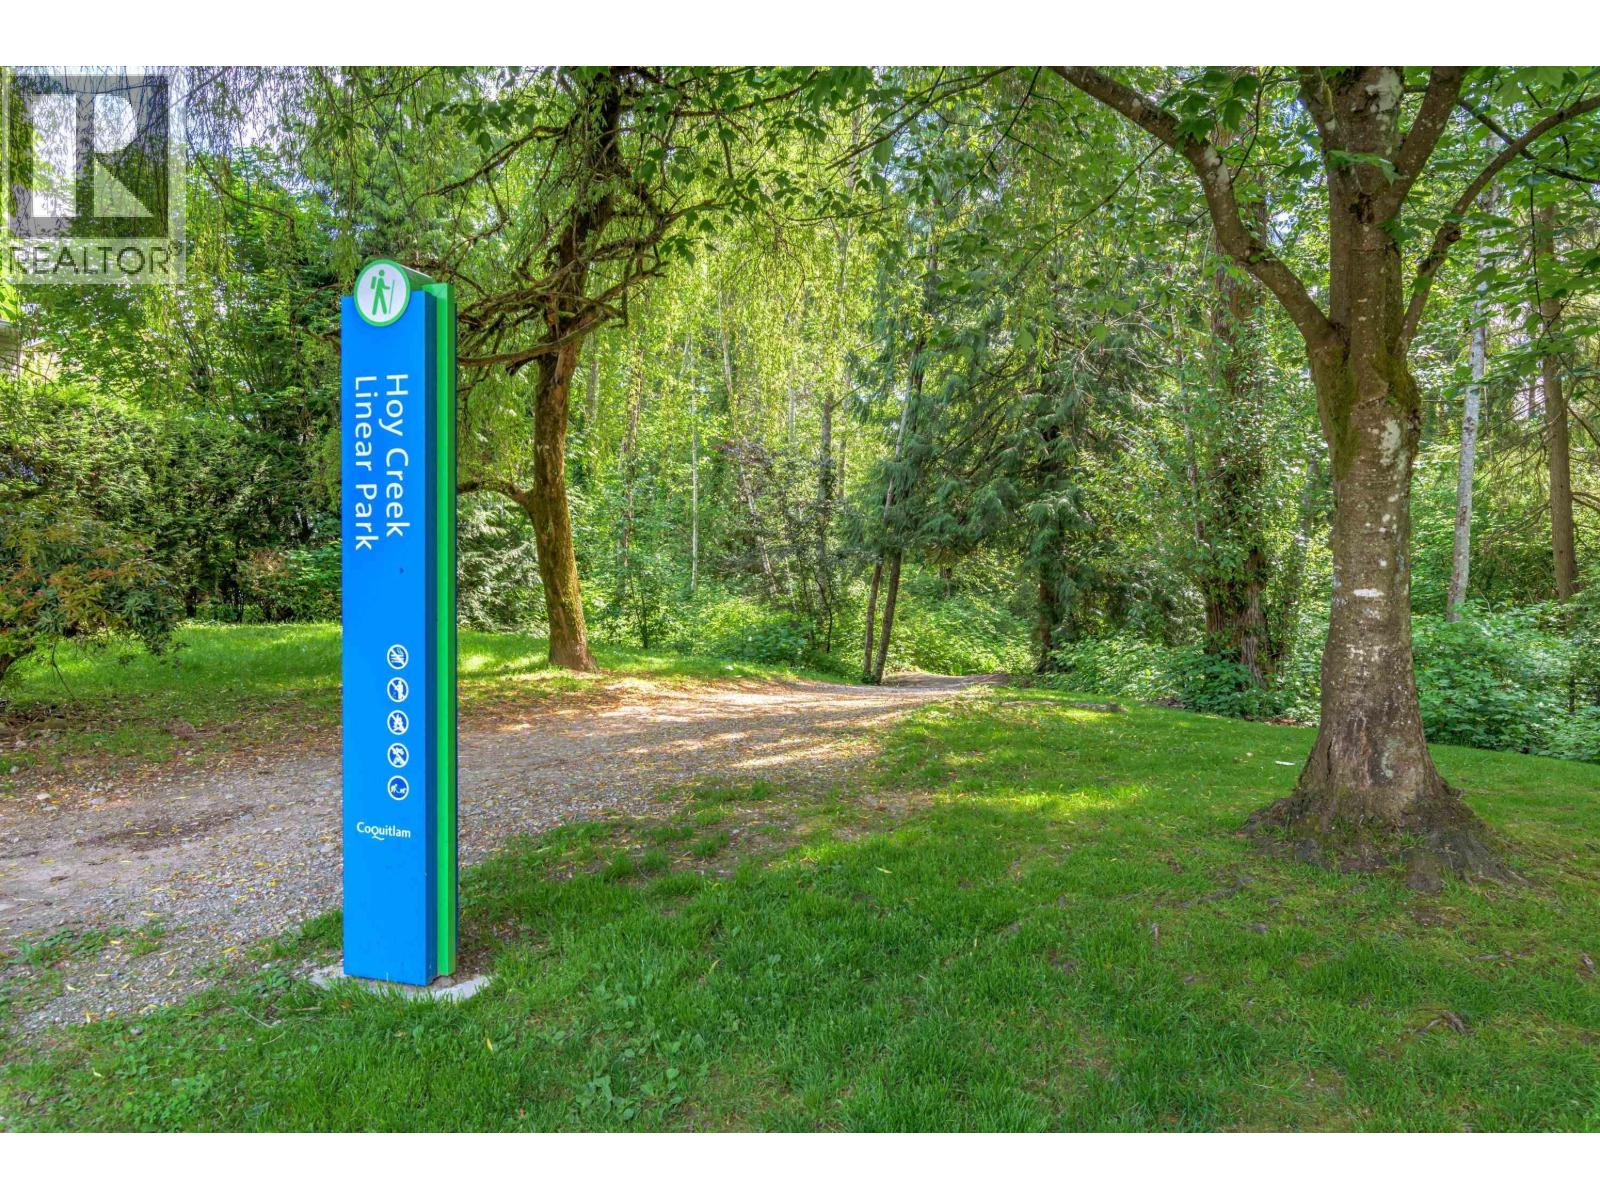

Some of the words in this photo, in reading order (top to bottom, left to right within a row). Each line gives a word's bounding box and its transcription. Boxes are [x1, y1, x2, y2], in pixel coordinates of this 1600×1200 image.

[355, 376, 379, 472] Linear
[378, 374, 409, 437] Hoy
[355, 483, 380, 550] Park
[385, 447, 411, 538] Creek
